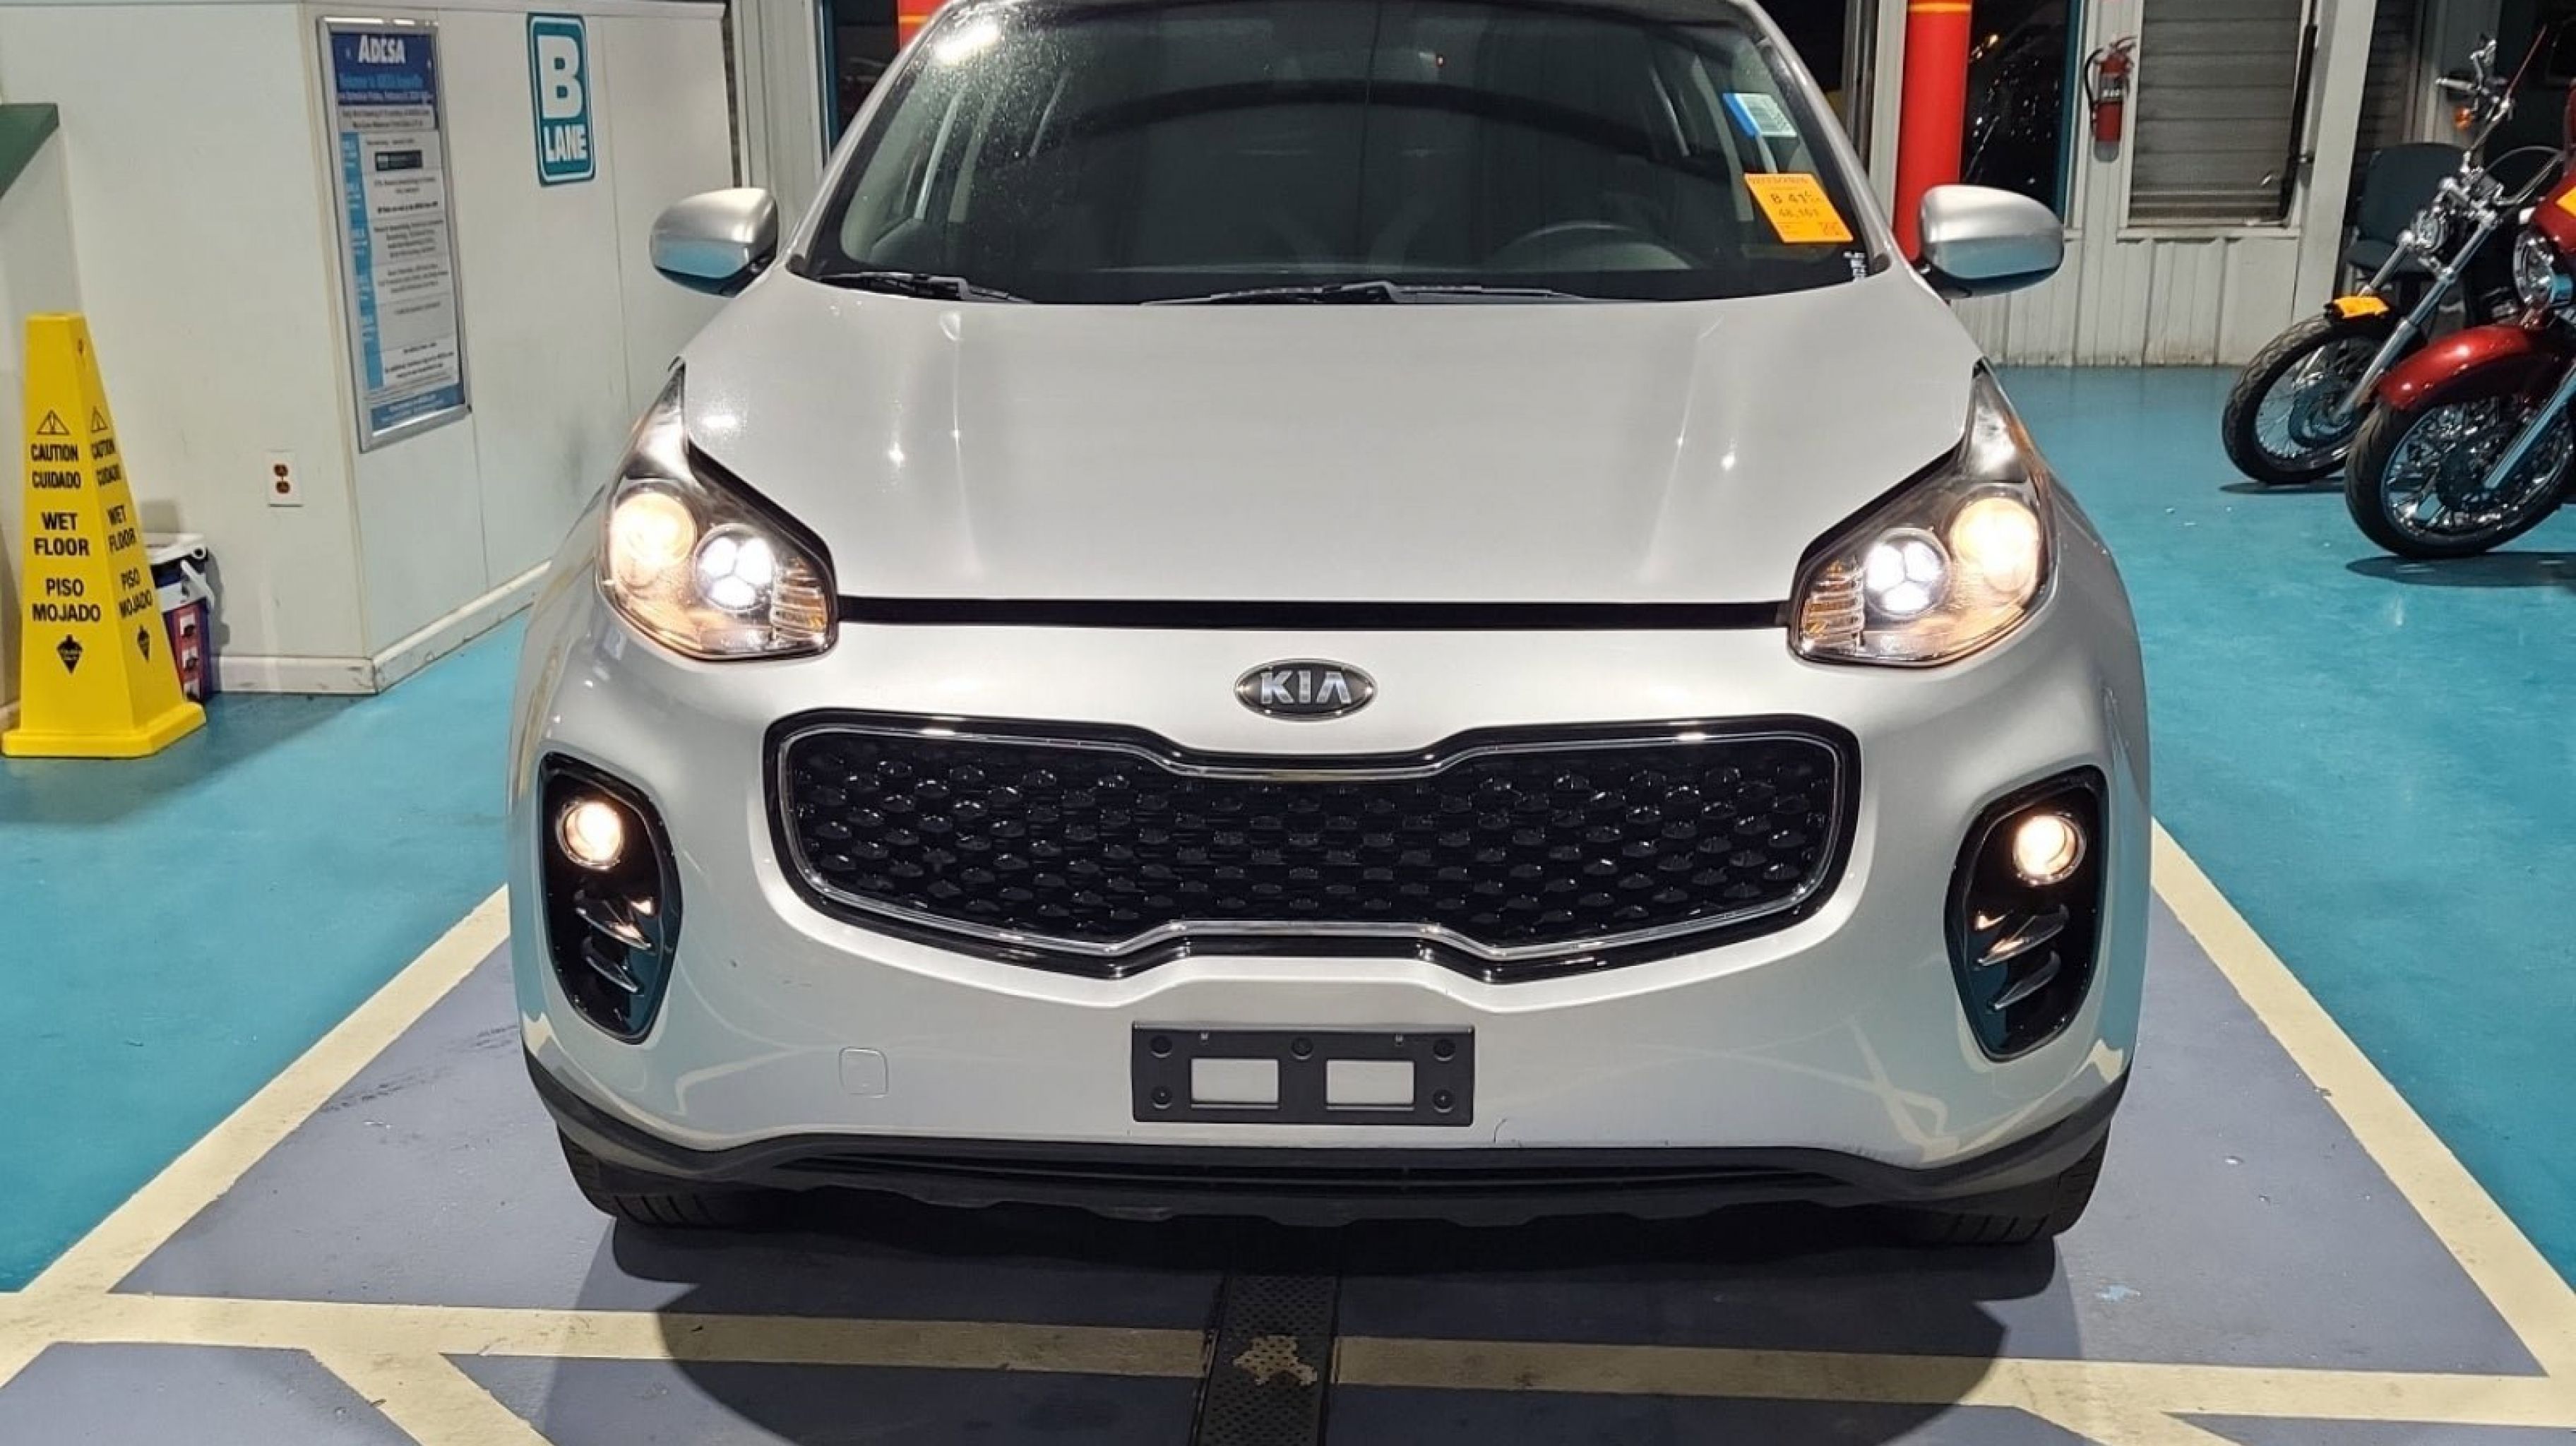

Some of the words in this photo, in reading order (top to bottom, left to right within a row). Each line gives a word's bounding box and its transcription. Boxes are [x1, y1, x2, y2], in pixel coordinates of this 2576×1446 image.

[358, 35, 407, 64] ADESA
[537, 35, 583, 119] B
[542, 124, 588, 162] LANE
[30, 443, 79, 461] CAUTION
[32, 471, 81, 489] CUIDADO
[40, 511, 78, 531] WET
[107, 505, 127, 525] WET
[33, 537, 90, 556] FLOOR
[107, 527, 137, 554] FLOOR
[45, 578, 85, 597] PISO
[120, 567, 141, 590] PISO
[32, 603, 101, 622] MOJADO
[119, 589, 153, 619] MOJADO
[1260, 669, 1352, 704] KIA
